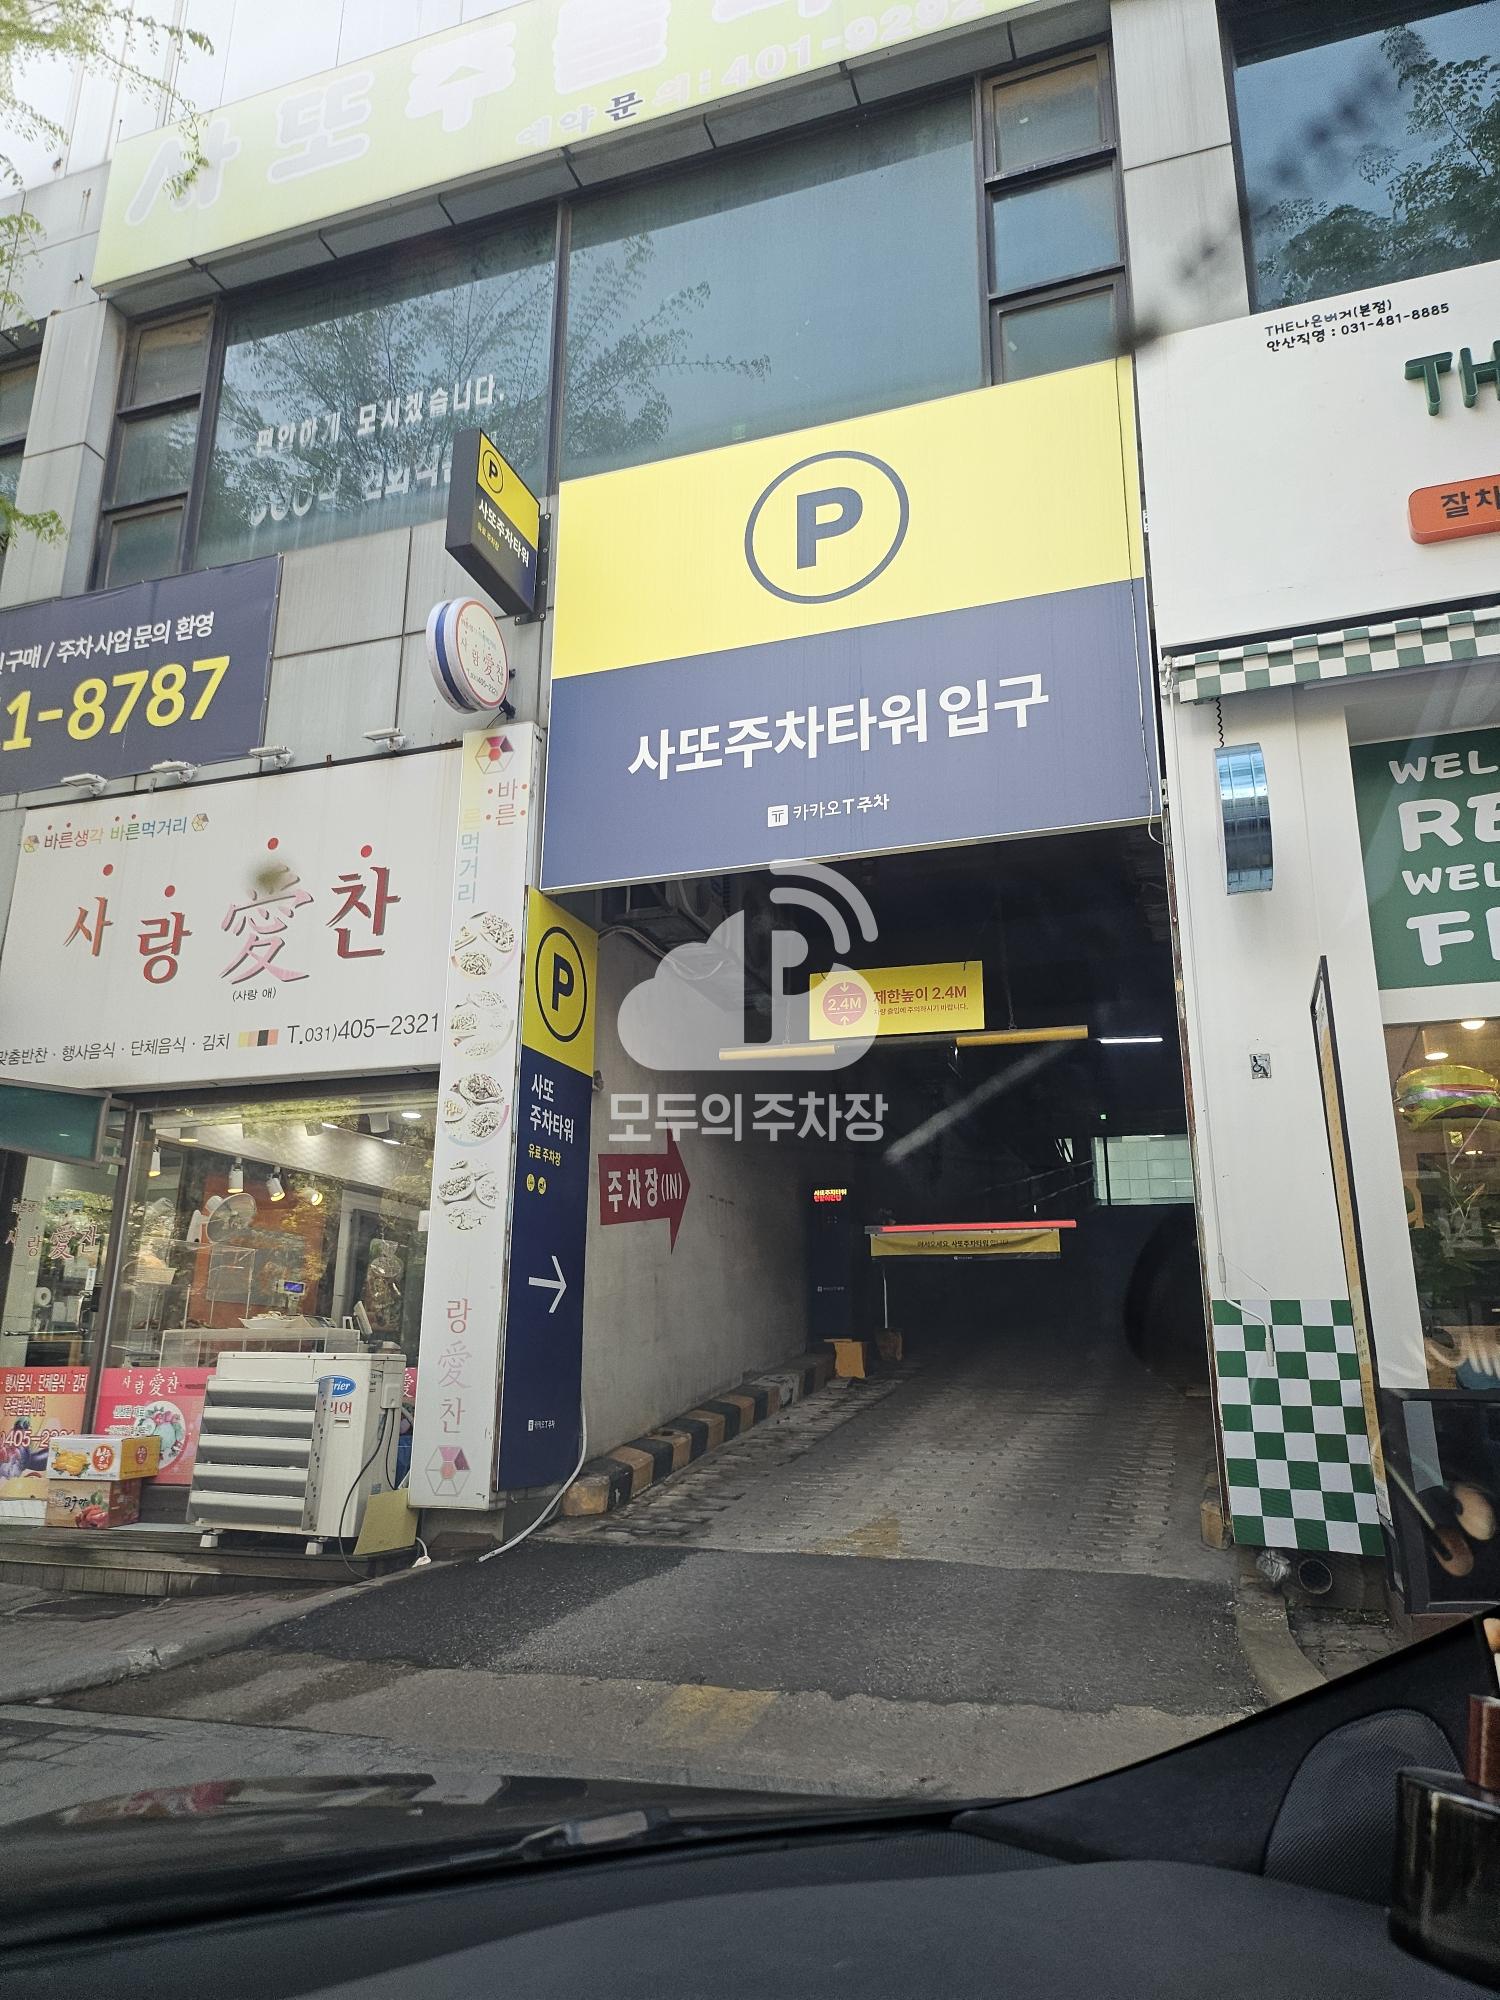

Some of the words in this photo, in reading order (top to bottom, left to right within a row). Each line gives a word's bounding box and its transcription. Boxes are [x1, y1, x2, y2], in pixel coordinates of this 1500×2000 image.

[1265, 299, 1392, 337] THE나은버거(본점)
[1267, 329, 1325, 352] 안산직영
[1341, 303, 1449, 335] 031-481-8885
[358, 374, 505, 436] 모시겠습니다.
[478, 498, 529, 568] 사또주차타워
[0, 645, 43, 675] 구매
[628, 683, 928, 781] 사또주차타워
[938, 672, 1050, 740] 입구
[43, 827, 104, 851] 바른생각
[110, 816, 188, 842] 바른먹거리
[828, 997, 862, 1011] 2.4M
[874, 989, 928, 1005] 제한높이
[932, 985, 967, 1000] 2.4M
[62, 1042, 116, 1062] 행사음식
[131, 1036, 187, 1056] 단체음식
[202, 1033, 231, 1051] 김치
[531, 1073, 554, 1102] 사또
[530, 1104, 574, 1144] 주차타워
